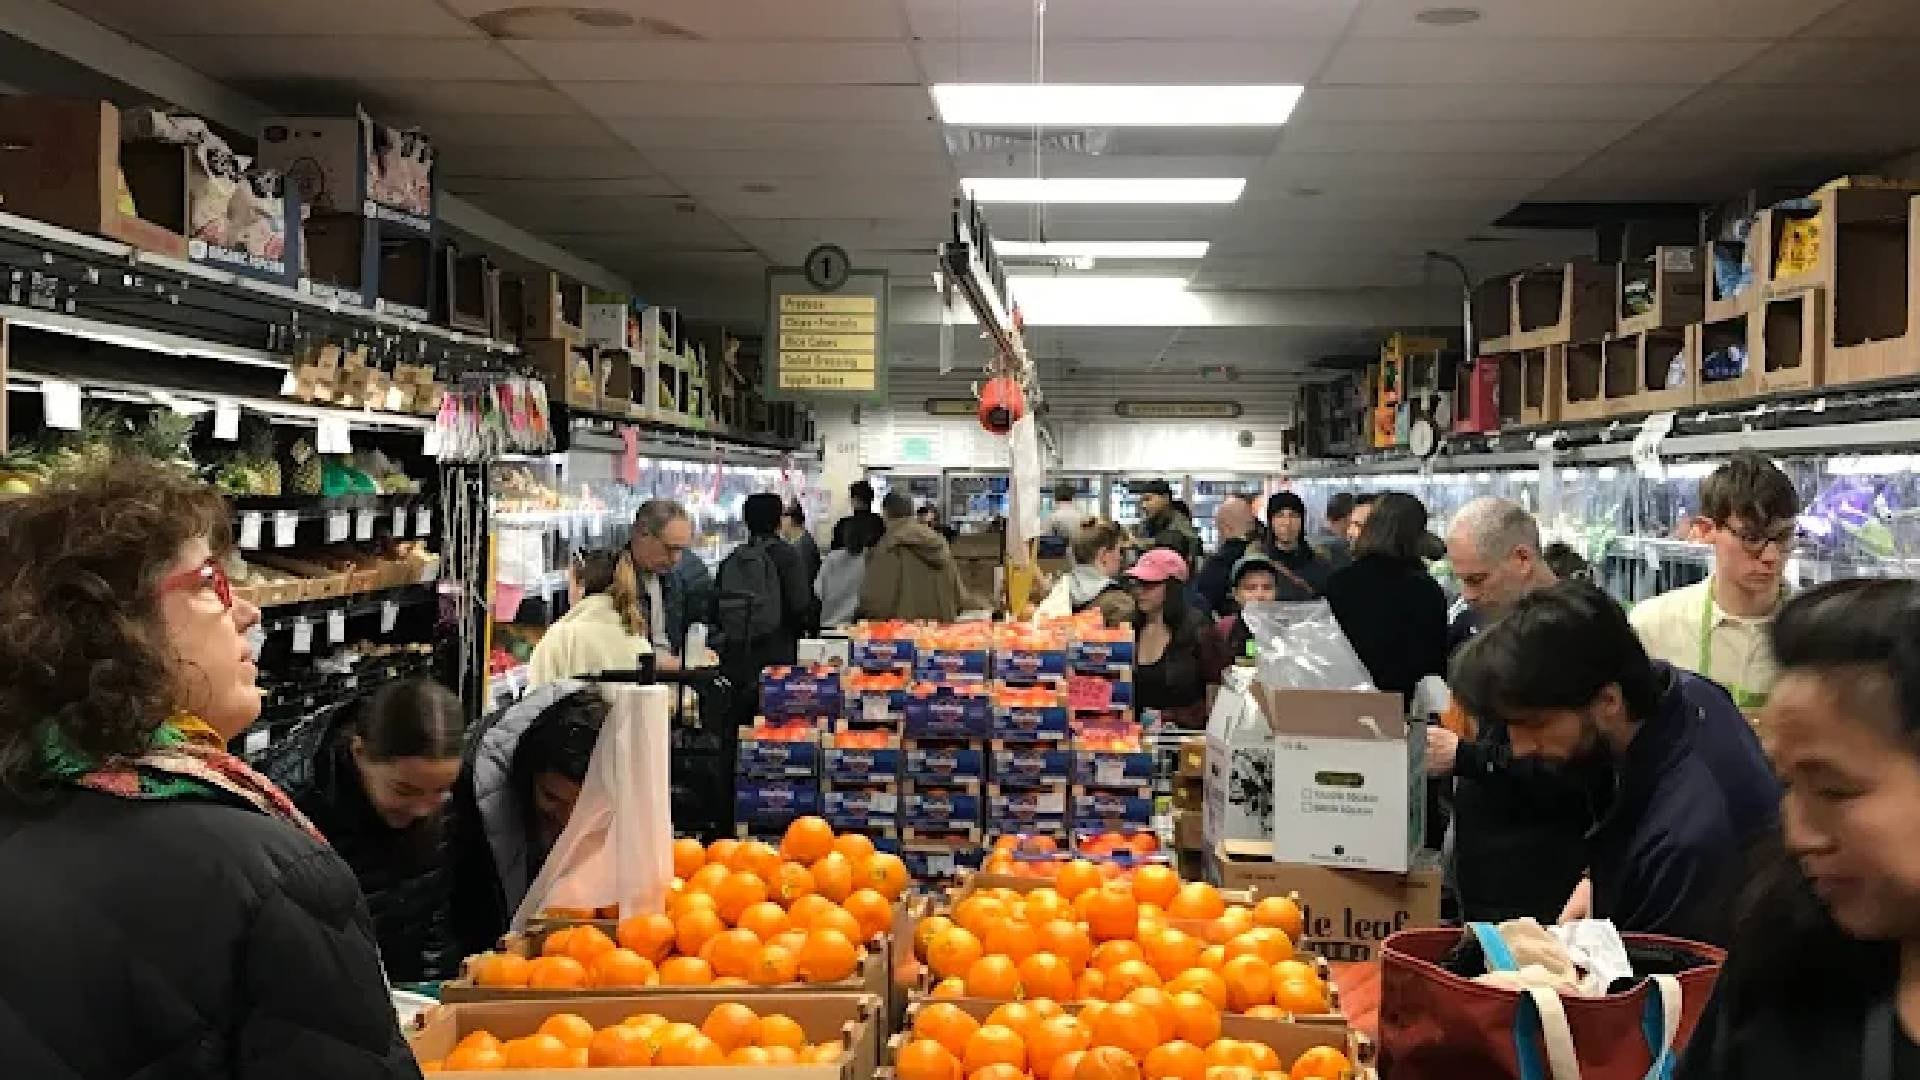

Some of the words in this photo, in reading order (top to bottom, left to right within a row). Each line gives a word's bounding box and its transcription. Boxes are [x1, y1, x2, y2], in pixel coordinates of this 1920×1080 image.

[820, 257, 831, 279] 1
[784, 297, 825, 310] Produce
[784, 337, 806, 348] Rice
[808, 337, 838, 348] Cakes
[784, 355, 811, 366] Salad
[814, 355, 858, 369] Dressing
[784, 375, 812, 388] Apple
[816, 374, 844, 385] Sauce
[1303, 904, 1333, 937] le
[1343, 907, 1411, 941] leaf
